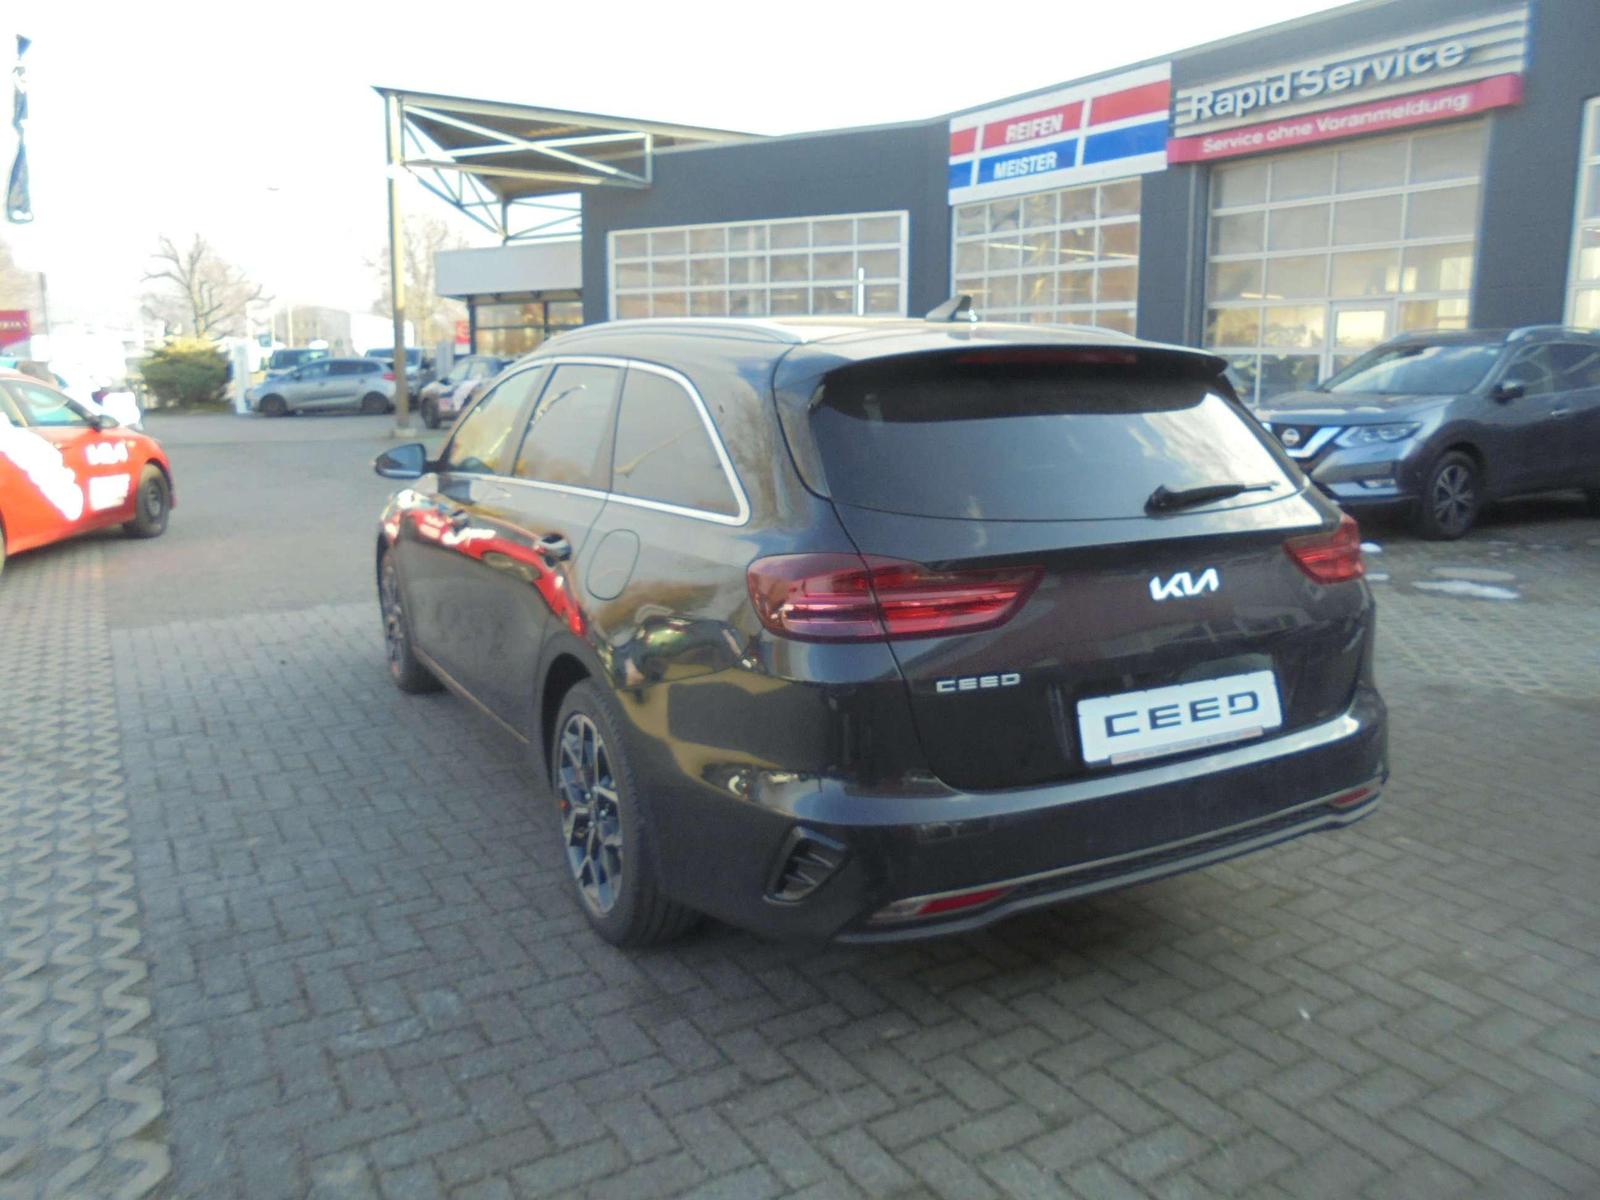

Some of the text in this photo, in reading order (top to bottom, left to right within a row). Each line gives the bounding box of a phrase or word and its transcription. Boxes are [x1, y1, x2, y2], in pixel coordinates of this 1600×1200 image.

[1005, 113, 1063, 143] REIFEN
[1203, 93, 1470, 153] Service ohne Voranmeldung
[993, 151, 1057, 179] MEISTER
[936, 673, 1021, 693] CEED
[1104, 691, 1260, 738] CEED
